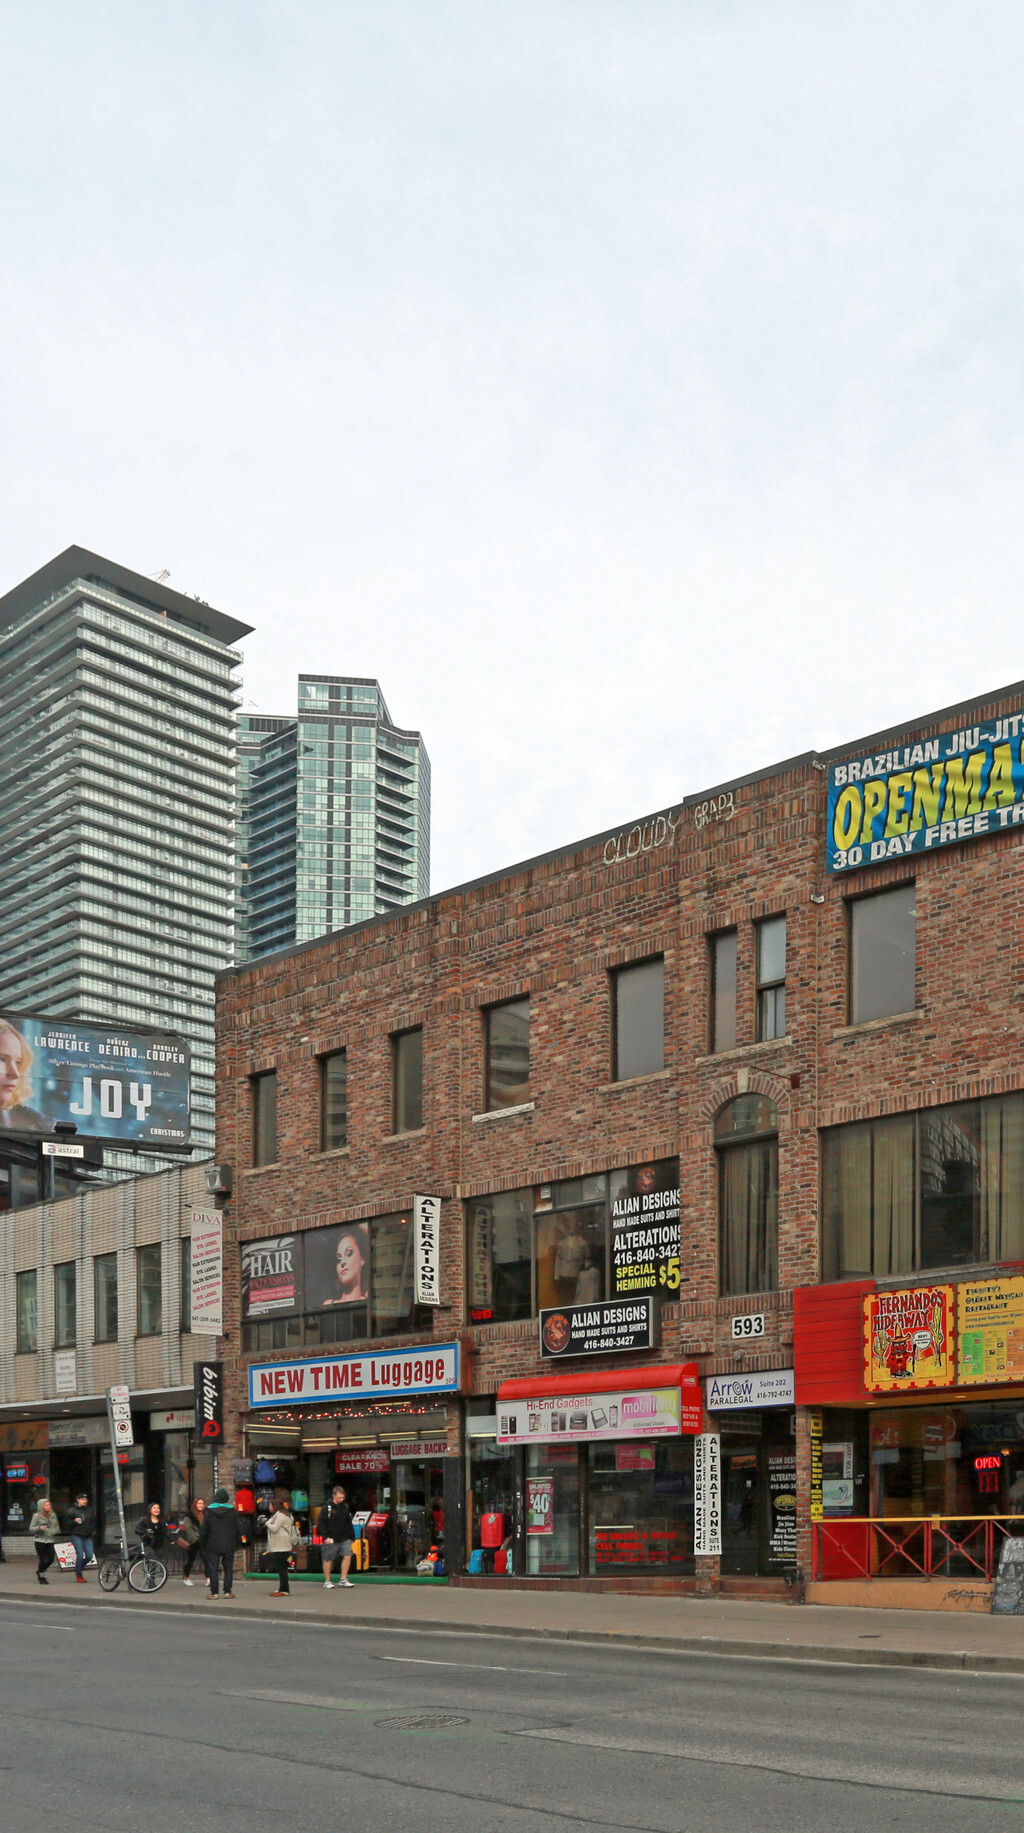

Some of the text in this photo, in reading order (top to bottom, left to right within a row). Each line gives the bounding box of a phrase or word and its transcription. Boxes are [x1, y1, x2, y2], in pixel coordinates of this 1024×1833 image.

[834, 739, 940, 787] BRAZILIAN
[603, 811, 680, 865] CLOUDY
[832, 849, 863, 870] 30
[870, 832, 918, 862] DAY
[924, 812, 990, 848] FREE
[34, 1036, 90, 1052] LAWRENCE
[146, 1050, 185, 1064] COOPER
[48, 1032, 76, 1040] JENNIFER
[153, 1044, 178, 1052] BRADLEY
[69, 1076, 152, 1121] JOY
[150, 1128, 184, 1138] CHRISTMAS
[57, 1146, 80, 1154] astral
[612, 1196, 640, 1216] ALIAN
[193, 1212, 220, 1225] DIVA
[612, 1210, 665, 1228] HAND MADE SUITS AND
[420, 1198, 436, 1290] ALTERATIONS
[250, 1250, 294, 1278] HAIR
[616, 1257, 681, 1290] SPECIAL $5
[616, 1275, 656, 1292] HEMMING
[966, 1285, 1001, 1295] TORONTO'S
[878, 1288, 945, 1315] FERNANDO'S
[965, 1292, 1023, 1304] OLDEST MEXICAN
[965, 1302, 1008, 1312] RESTAURANT
[571, 1310, 600, 1328] ALIAN
[604, 1304, 647, 1324] DESIGNS
[872, 1309, 930, 1332] HIDEAWAY
[571, 1322, 647, 1339] HAND MADE SUITS AND SHIRTS
[734, 1316, 763, 1336] 593
[584, 1336, 634, 1350] 416-840-3427
[260, 1358, 445, 1396] NEW TIME Luggage
[710, 1379, 753, 1397] Arrow
[201, 1366, 220, 1438] bibimQ
[526, 1396, 593, 1411] Hi-End Gadgets
[710, 1390, 792, 1406] PARALEGAL 416-792-4747
[342, 1453, 387, 1461] CLEARANCE
[392, 1443, 422, 1456] LUGGAGE
[364, 1462, 383, 1470] 70%
[974, 1456, 1001, 1470] OPEN
[710, 1437, 718, 1536] ALTERATIONS
